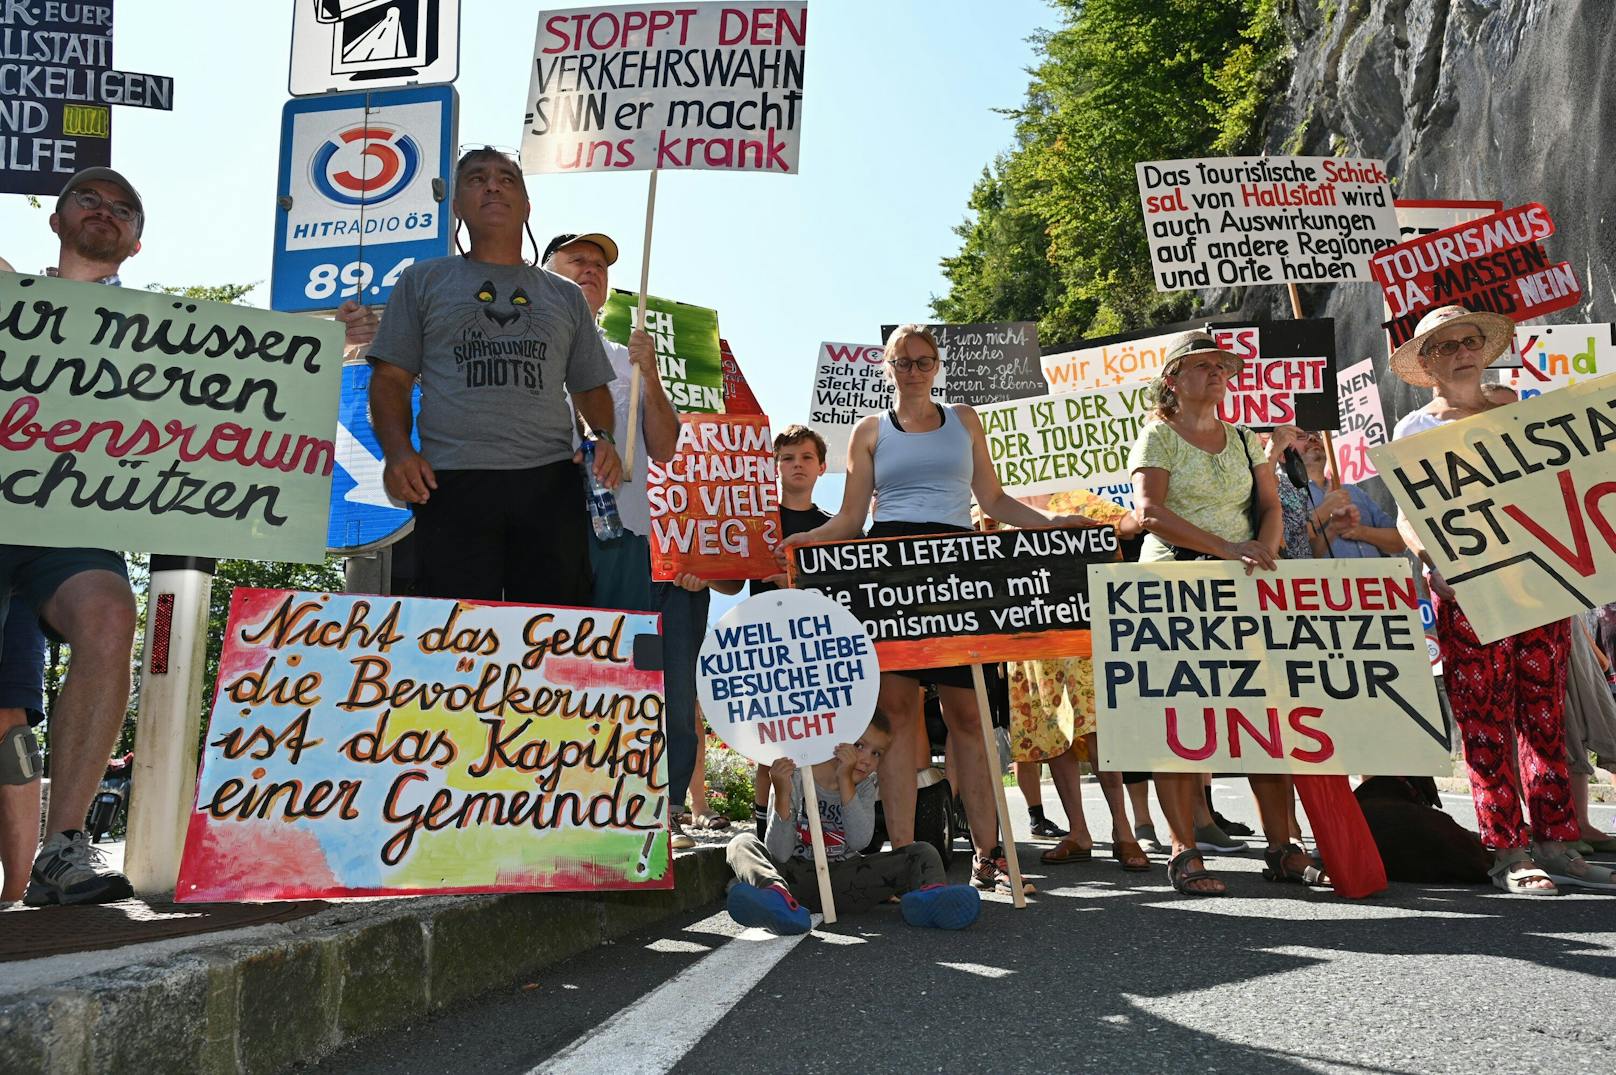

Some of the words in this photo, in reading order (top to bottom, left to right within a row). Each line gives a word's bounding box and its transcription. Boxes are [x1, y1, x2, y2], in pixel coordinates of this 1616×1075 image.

[0, 28, 113, 67] LLSTATT
[542, 9, 697, 54] STOPPT
[718, 8, 807, 47] DEN
[536, 49, 806, 94] VERKEHRSWAHN
[614, 101, 654, 131] er
[667, 90, 803, 131] macht
[555, 137, 636, 169] uns
[656, 126, 790, 172] krank
[1144, 165, 1191, 189] Das
[1146, 187, 1190, 213] sal
[1191, 190, 1235, 209] von
[1241, 182, 1337, 207] Hallstatt
[1342, 184, 1386, 208] wird
[293, 217, 400, 239] HITRADIO
[404, 212, 433, 230] Ö3
[1152, 212, 1211, 238] auch
[1220, 207, 1377, 238] Auswirkungen
[1156, 237, 1197, 264] auf
[1207, 233, 1289, 260] andere
[1297, 231, 1398, 261] Regionen
[1374, 207, 1551, 284] TOURISMUS
[304, 257, 415, 300] 89.4
[1160, 262, 1210, 289] und
[1217, 257, 1273, 284] Orte
[1282, 256, 1357, 281] haben
[1516, 263, 1580, 308] NEIN
[1385, 279, 1431, 319] JA
[90, 302, 322, 374] müssen
[629, 306, 675, 335] ICH
[954, 333, 983, 346] uns
[986, 327, 1029, 346] nicht
[454, 340, 547, 364] SURROUNDED
[1215, 331, 1258, 360] ES
[0, 349, 287, 421] unseren
[466, 359, 543, 390] IDIOTS!
[657, 355, 687, 380] IN
[817, 376, 869, 391] steckt
[871, 379, 896, 394] die
[820, 362, 854, 376] sich
[859, 364, 884, 378] die
[996, 357, 1032, 380] geht
[1045, 357, 1090, 385] wir
[1339, 369, 1376, 398] NEN
[812, 407, 865, 425] schüt
[1030, 401, 1055, 428] IST
[1065, 394, 1113, 422] DER
[1216, 393, 1296, 424] UNS
[0, 395, 336, 477] bensraum
[990, 432, 1033, 461] DER
[1393, 400, 1616, 509] HALLSTA
[647, 453, 776, 485] SCHAUEN
[993, 445, 1131, 487] LBSTZERSTÖR
[0, 451, 288, 527] chützen
[646, 484, 688, 517] SO
[699, 484, 779, 517] VIELE
[651, 518, 750, 558] WEG
[1424, 498, 1511, 562] IST
[798, 543, 893, 575] UNSER
[898, 535, 1010, 567] LETZTER
[1012, 527, 1119, 558] AUSWEG
[859, 573, 993, 609] Touristen
[1007, 567, 1051, 599] mit
[1106, 579, 1238, 615] KEINE
[1256, 577, 1420, 612] NEUEN
[241, 594, 406, 649] Nicht
[417, 602, 499, 657] das
[522, 613, 628, 669] Geld
[715, 622, 782, 650] WEIL
[788, 614, 832, 640] ICH
[1108, 614, 1415, 652] PARKPLÄTZE
[700, 644, 794, 677] KULTUR
[800, 634, 868, 663] LIEBE
[224, 655, 322, 706] die
[336, 656, 664, 744] Bevölkerung
[711, 665, 821, 701] BESUCHE
[826, 659, 865, 685] ICH
[1104, 659, 1267, 709] PLATZ
[727, 685, 853, 724] HALLSTATT
[757, 712, 837, 745] NICHT
[1164, 705, 1335, 764] UNS
[212, 707, 324, 765] ist
[340, 709, 458, 768] das
[468, 718, 669, 793] Kapital
[198, 768, 362, 822] einer
